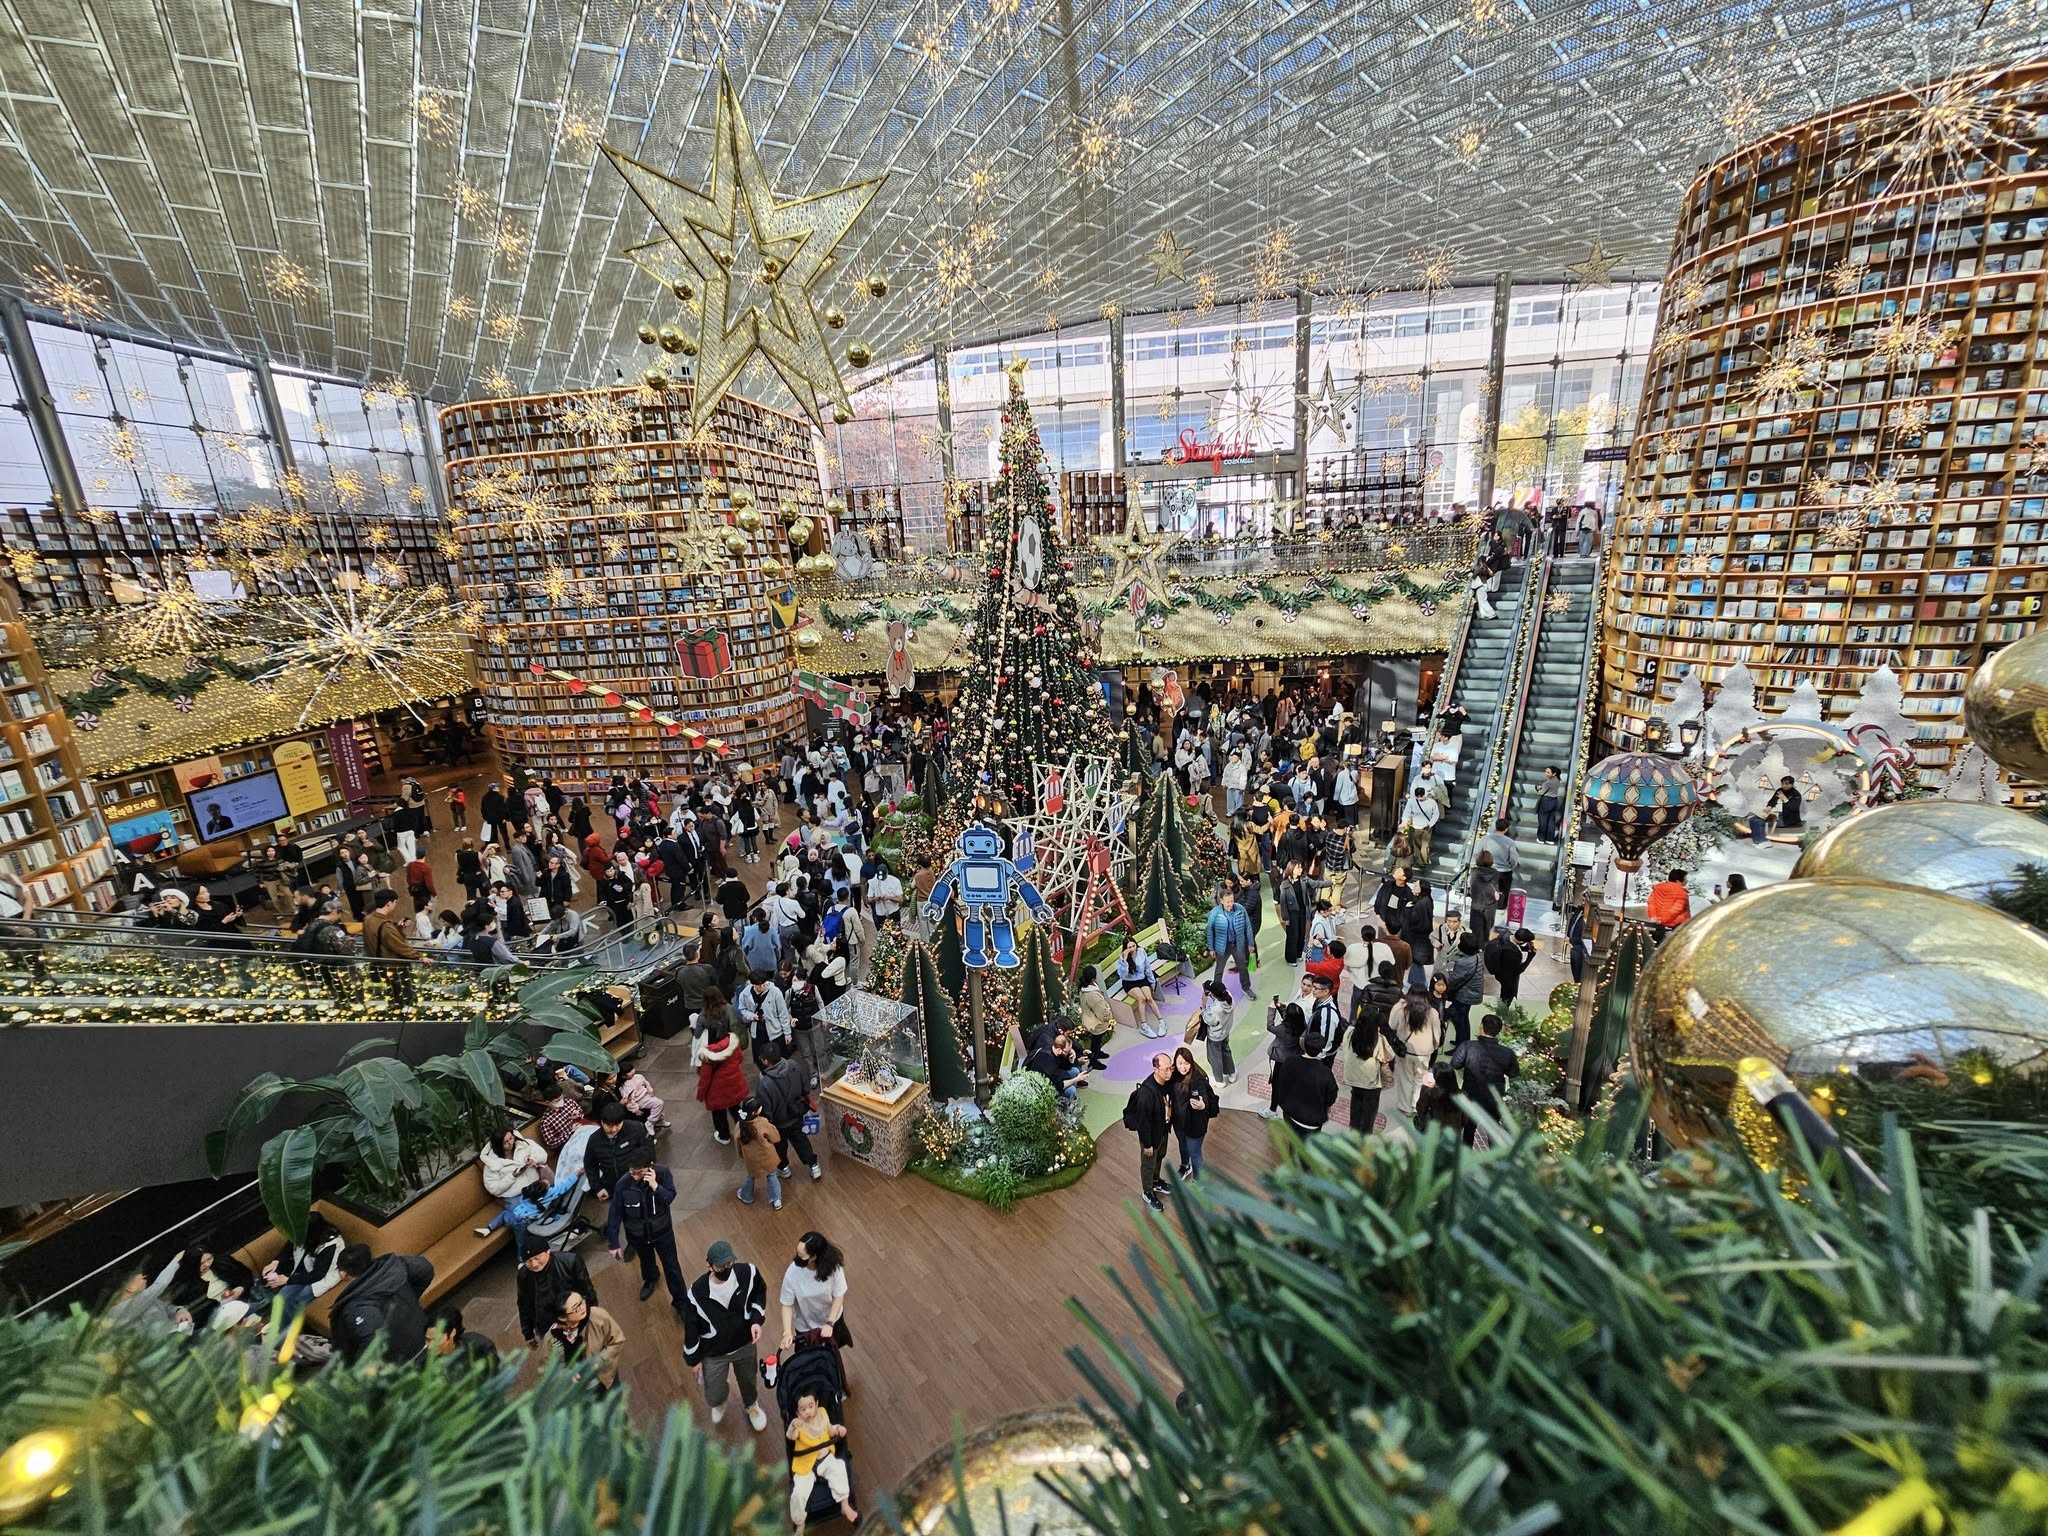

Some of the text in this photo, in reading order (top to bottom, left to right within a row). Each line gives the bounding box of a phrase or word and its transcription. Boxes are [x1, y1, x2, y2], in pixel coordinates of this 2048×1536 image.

[1646, 661, 1656, 673] C
[474, 698, 483, 708] B
[673, 695, 679, 705] B
[132, 872, 156, 893] A
